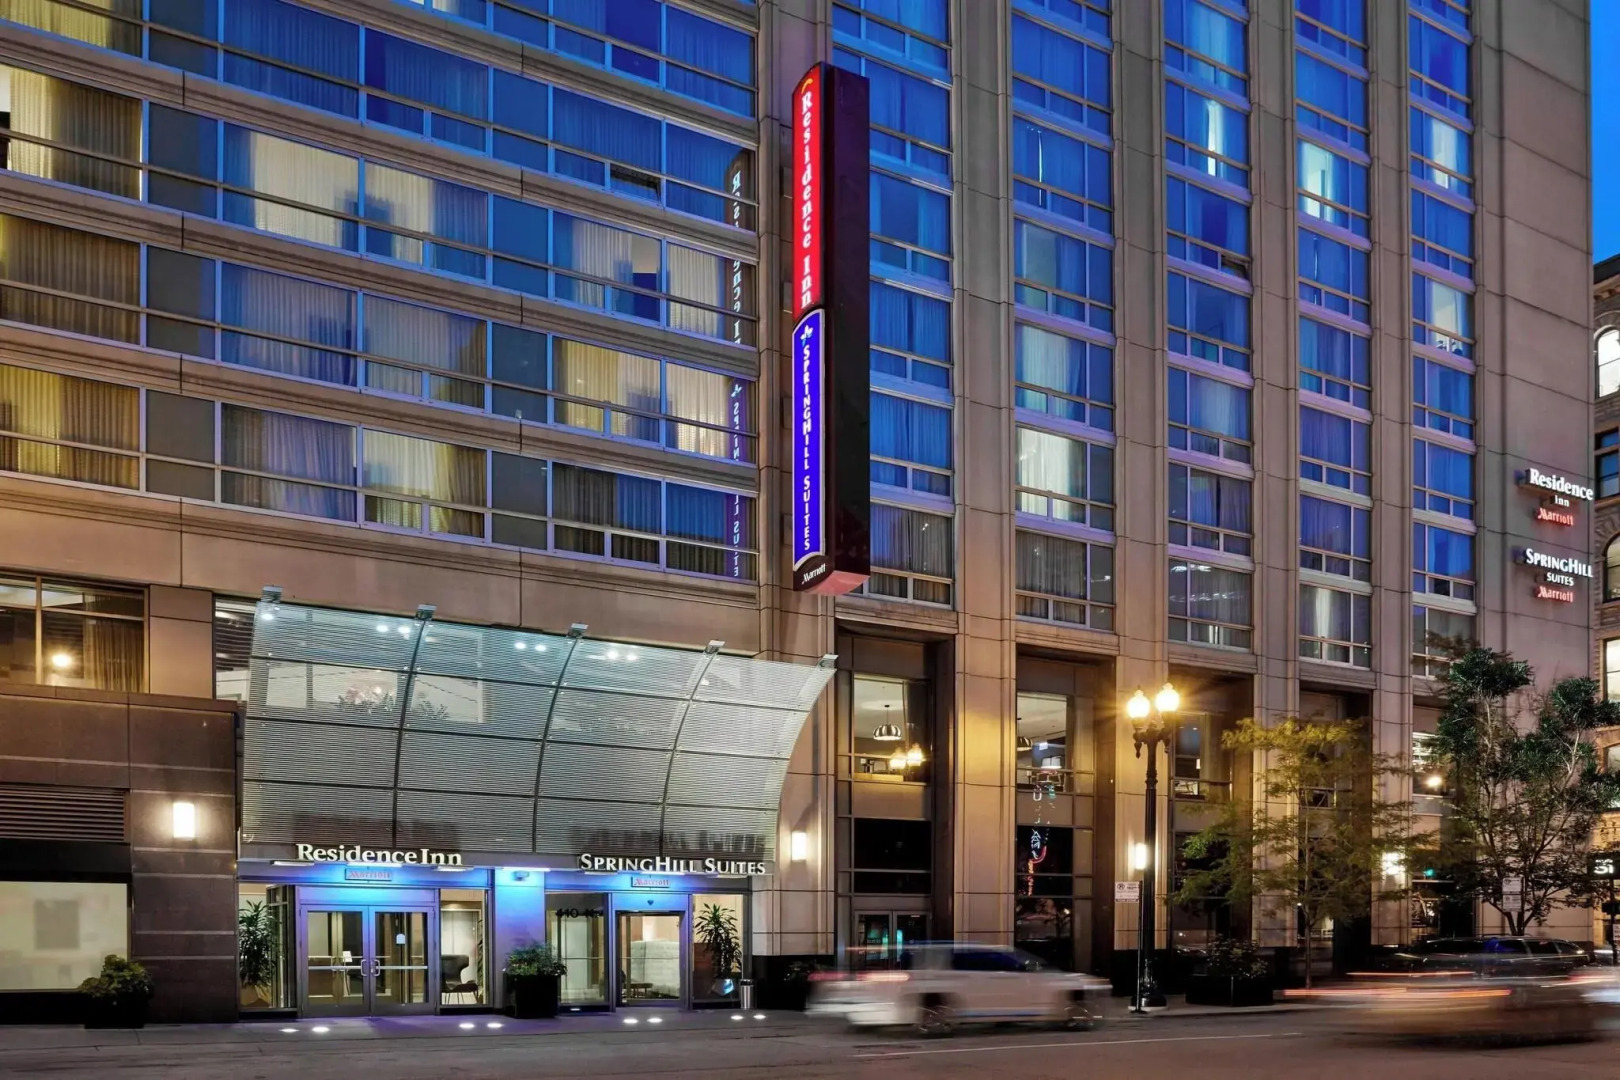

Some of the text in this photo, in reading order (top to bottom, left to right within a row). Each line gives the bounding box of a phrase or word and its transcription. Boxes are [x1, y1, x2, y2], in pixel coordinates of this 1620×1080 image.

[801, 91, 813, 309] Residence Inn
[803, 345, 811, 551] SPRINGHILL SUITES
[1530, 468, 1594, 501] Residence
[1554, 494, 1570, 507] Inn
[1537, 507, 1574, 526] Marriott
[801, 563, 826, 585] Marriott
[1525, 548, 1594, 578] SPRINGHILL
[1546, 572, 1574, 587] SUITES
[1537, 585, 1574, 603] Marriott
[296, 843, 463, 866] Residence Inn
[580, 853, 767, 875] SPRINGHILL SUITES
[633, 877, 670, 887] Marriott
